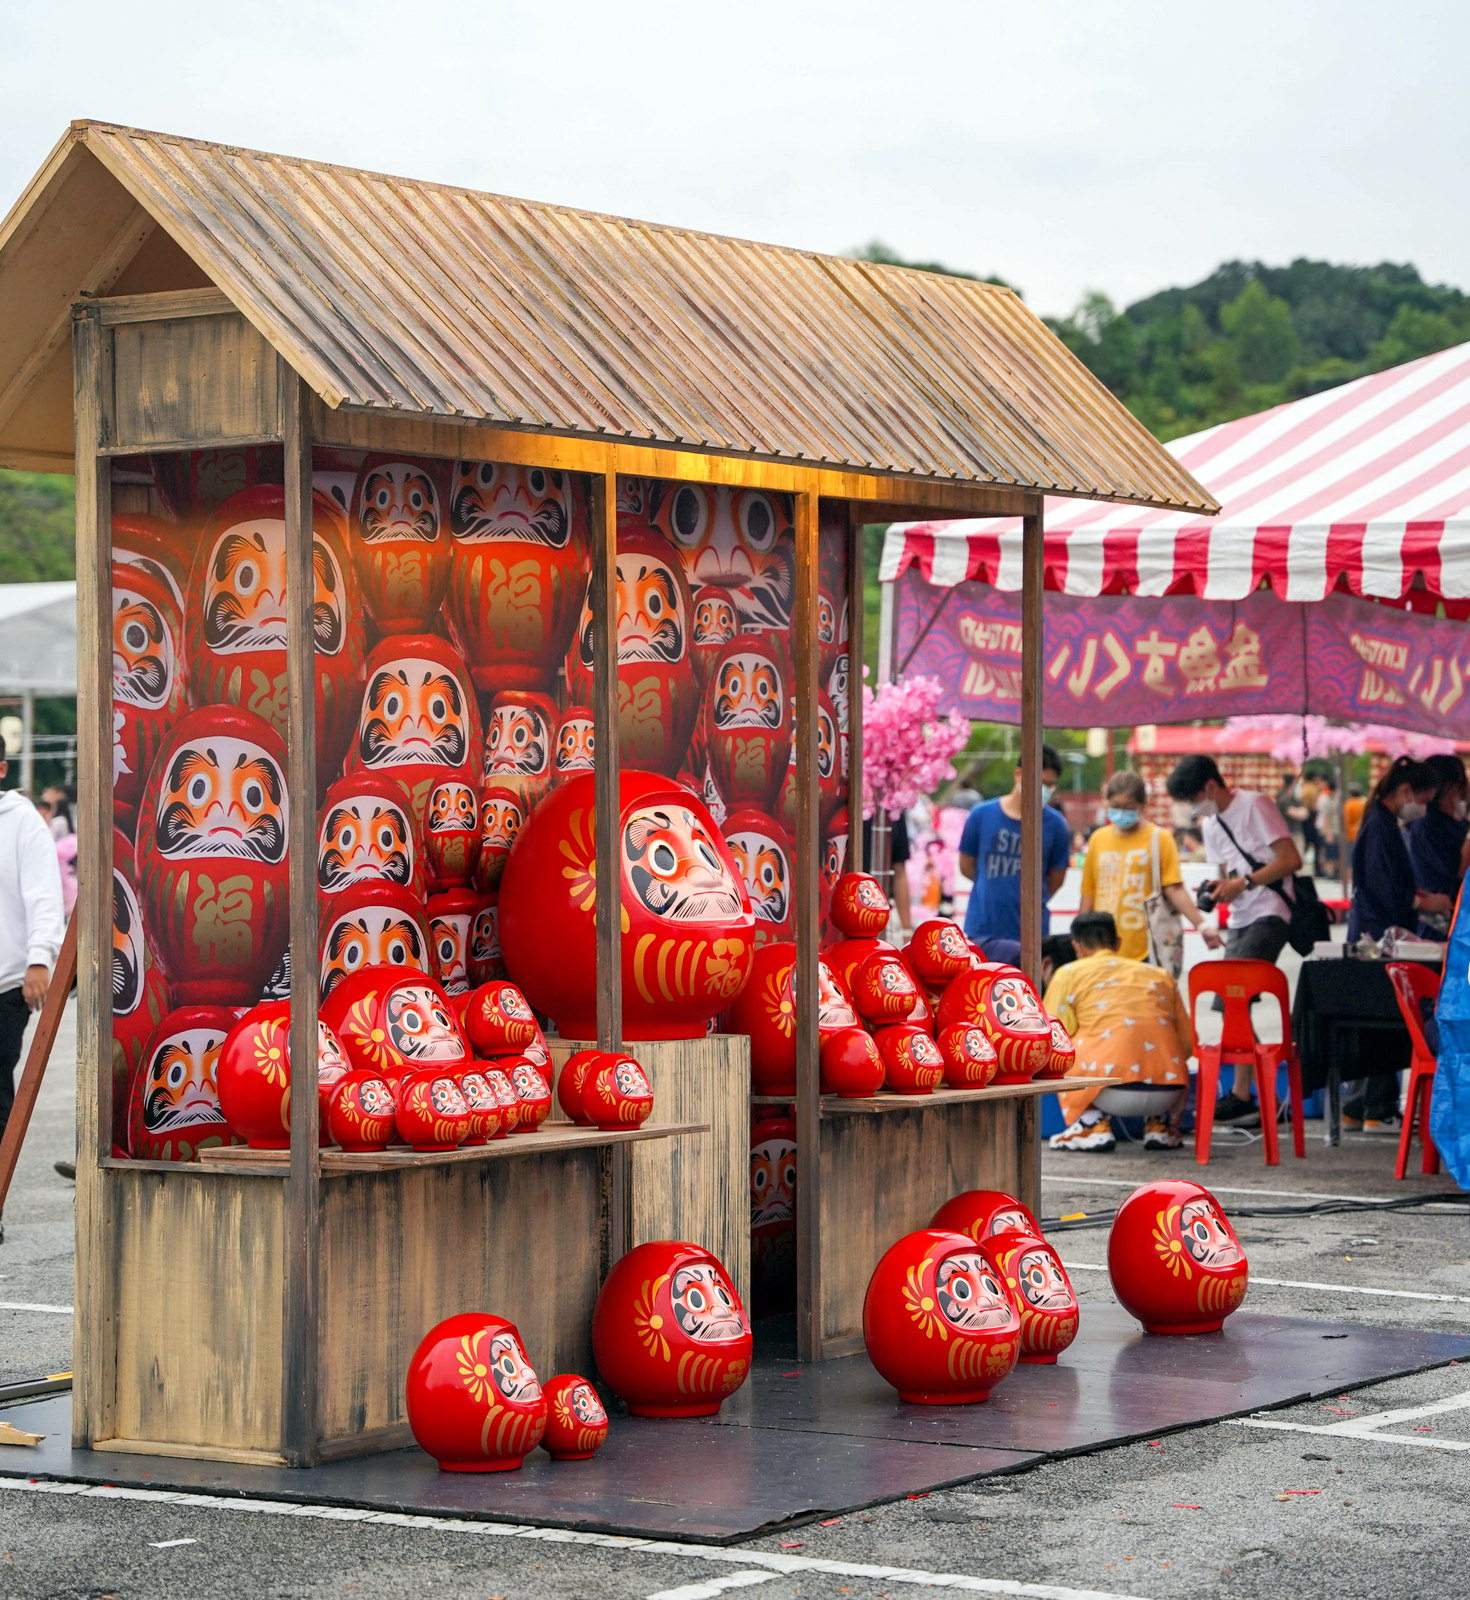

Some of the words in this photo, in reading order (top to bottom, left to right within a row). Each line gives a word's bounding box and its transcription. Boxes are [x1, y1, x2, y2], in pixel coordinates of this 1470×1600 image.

[386, 550, 423, 611] 福
[488, 558, 543, 653] 福
[618, 676, 664, 762] 福
[735, 737, 766, 784] 福
[444, 835, 466, 873] 福
[997, 828, 1022, 855] ST
[193, 873, 254, 966] 福
[704, 937, 745, 998] 福
